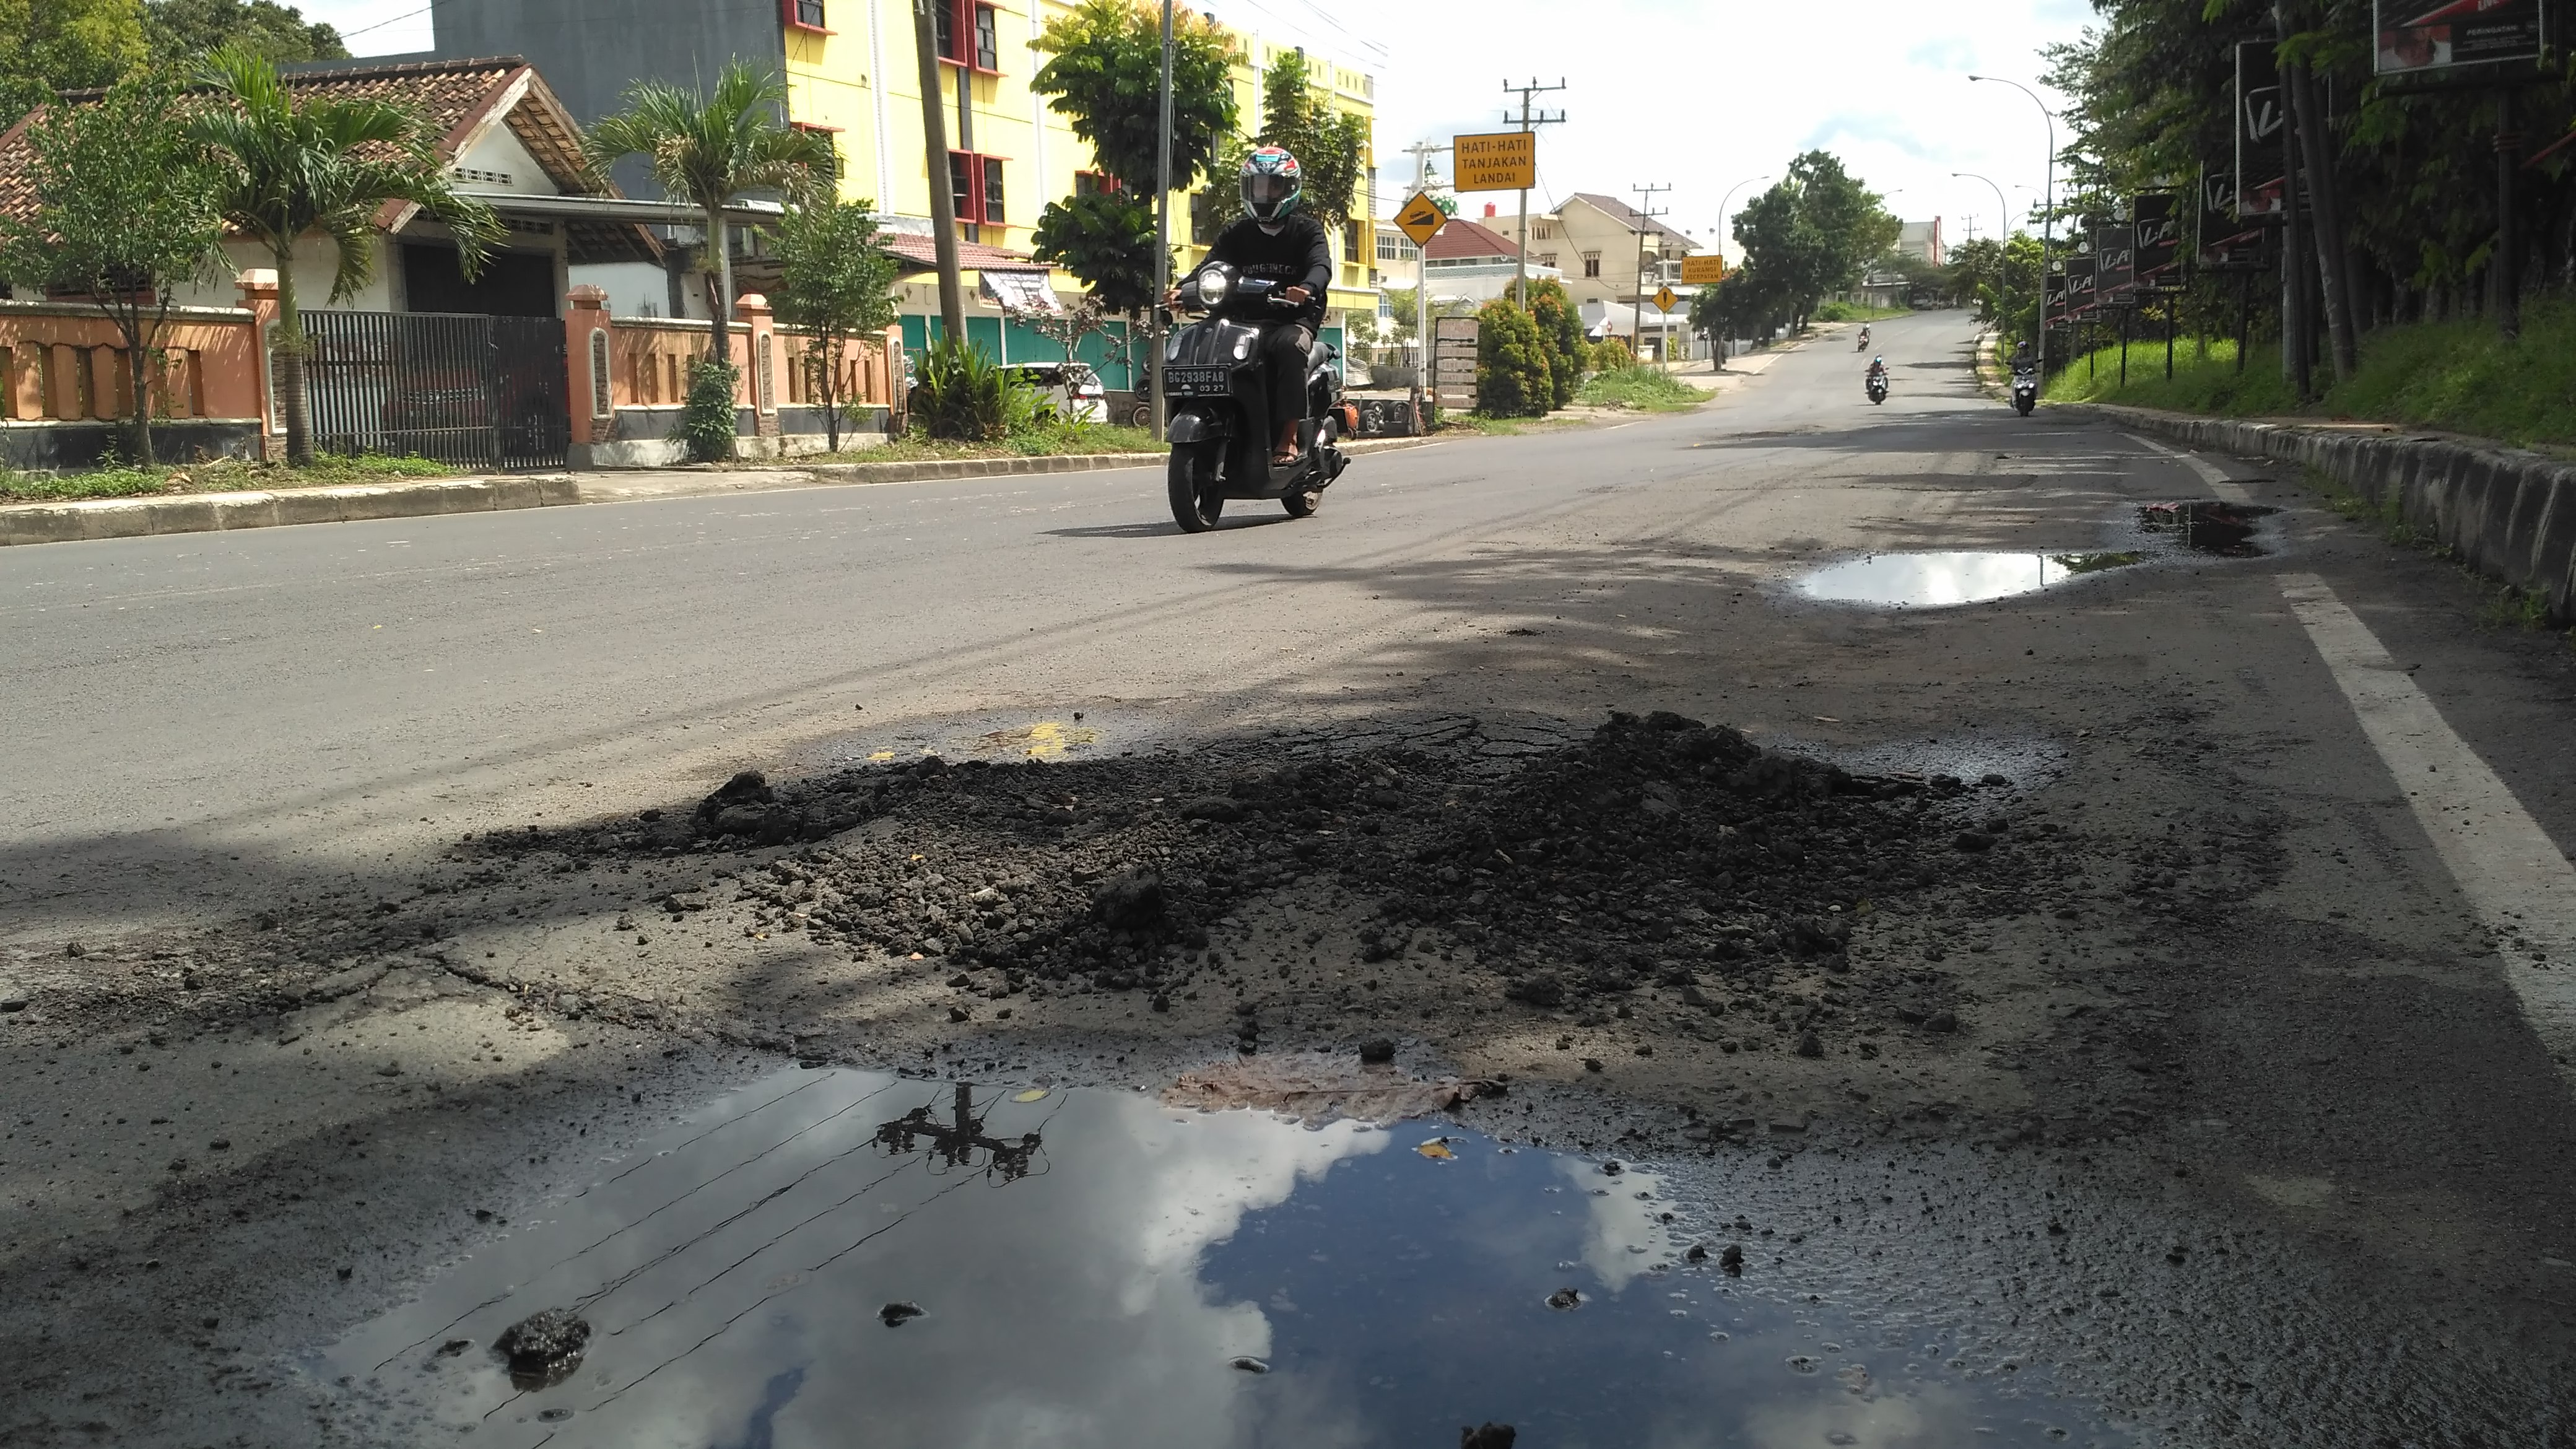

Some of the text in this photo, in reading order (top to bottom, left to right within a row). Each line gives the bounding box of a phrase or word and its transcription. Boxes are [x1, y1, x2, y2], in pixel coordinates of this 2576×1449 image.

[1462, 139, 1526, 154] HATI-HATI
[1462, 156, 1526, 169] TANJAKAN
[1474, 172, 1516, 184] LANDAI
